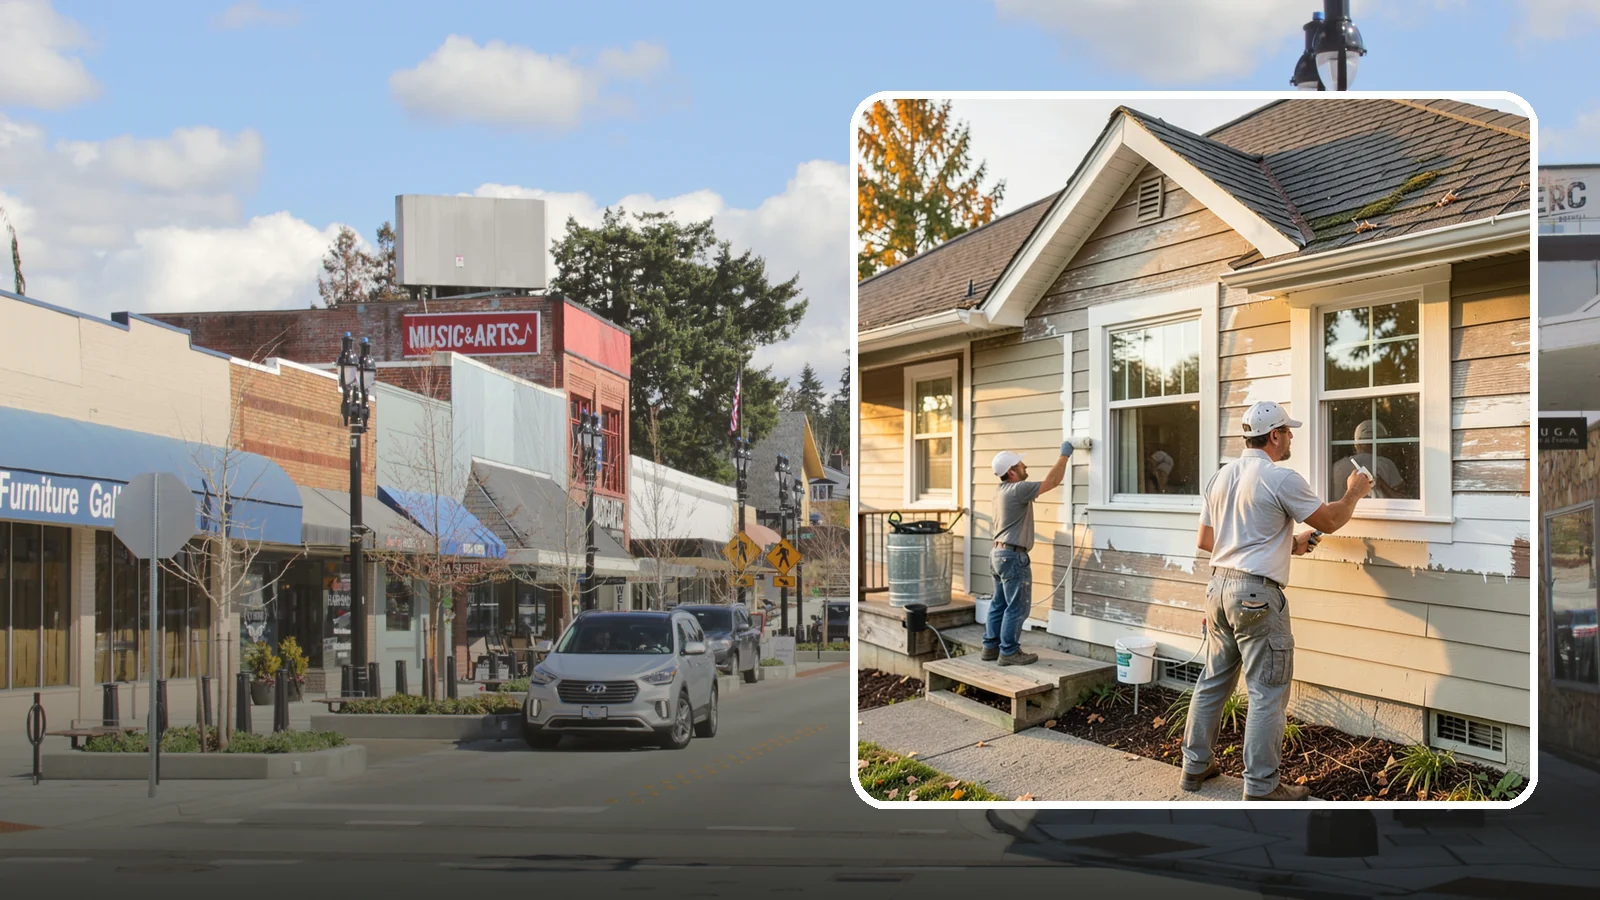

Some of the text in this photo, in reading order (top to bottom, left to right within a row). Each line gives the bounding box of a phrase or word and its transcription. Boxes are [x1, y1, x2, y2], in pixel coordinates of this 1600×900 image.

[409, 323, 519, 349] MUSIC&ARTS
[1540, 427, 1577, 436] UGA
[0, 472, 121, 519] Furniture Gal
